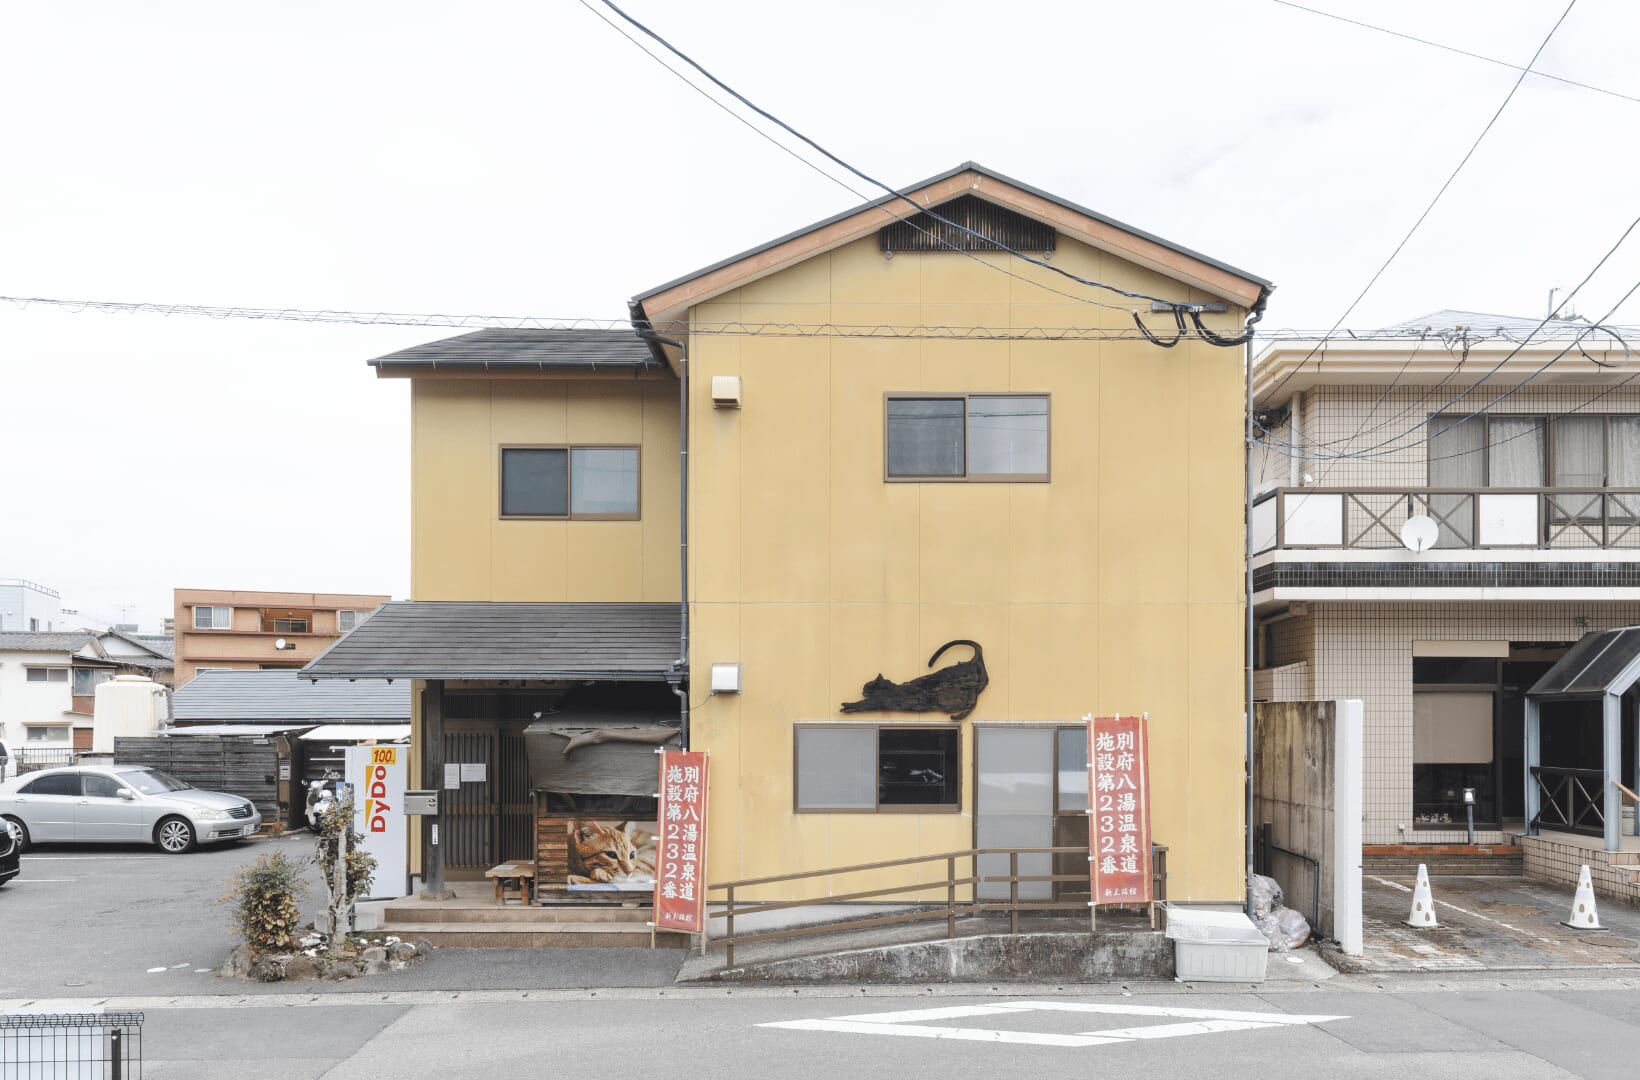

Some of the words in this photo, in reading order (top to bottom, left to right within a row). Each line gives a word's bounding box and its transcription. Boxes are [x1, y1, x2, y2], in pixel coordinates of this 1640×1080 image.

[371, 766, 391, 832] DyDo
[661, 765, 684, 899] 施設第232番
[679, 766, 699, 901] 別府八湯温泉道
[1096, 732, 1118, 873] 施設第232番
[1116, 731, 1139, 873] 別府八湯温泉道
